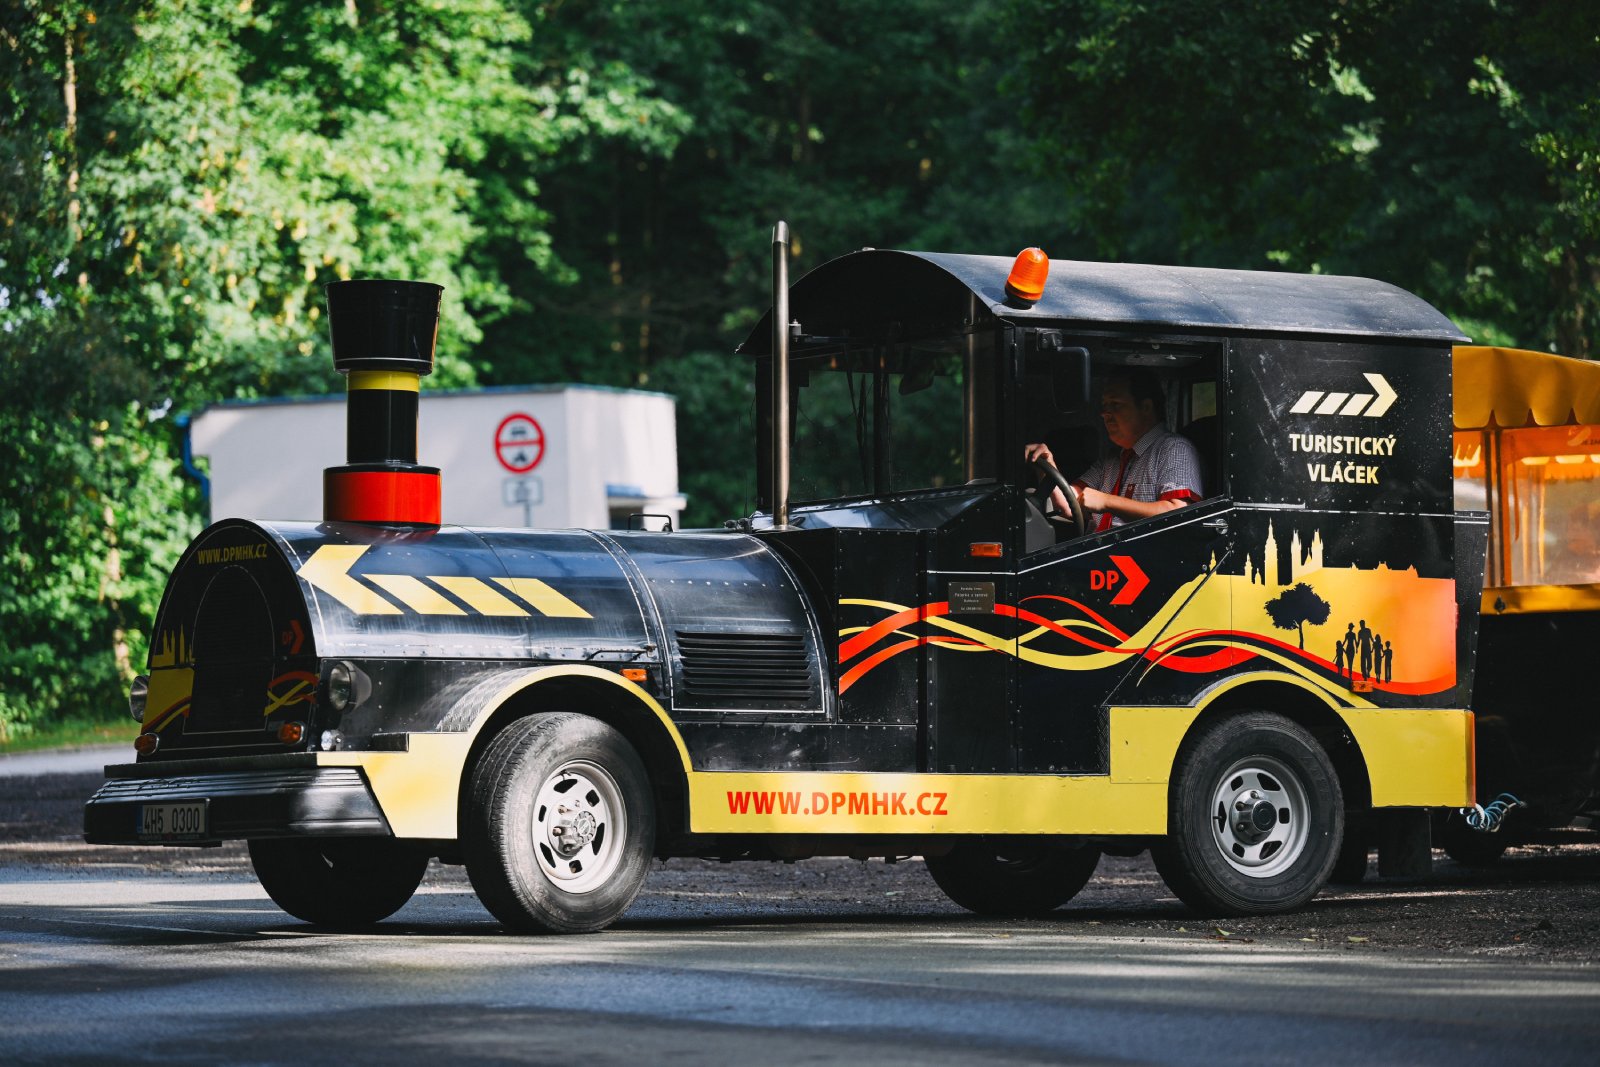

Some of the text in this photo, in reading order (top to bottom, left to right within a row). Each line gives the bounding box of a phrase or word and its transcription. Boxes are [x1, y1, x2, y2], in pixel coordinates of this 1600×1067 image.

[1289, 434, 1397, 456] TURISTICKÝ
[1307, 461, 1379, 484] VLÁČEK
[198, 543, 268, 564] WWW.DPMHK.CZ
[1090, 569, 1119, 590] DP
[281, 631, 293, 645] DP
[727, 791, 948, 815] WWW.DPMHK.CZ
[144, 807, 200, 833] 4H5 0300
